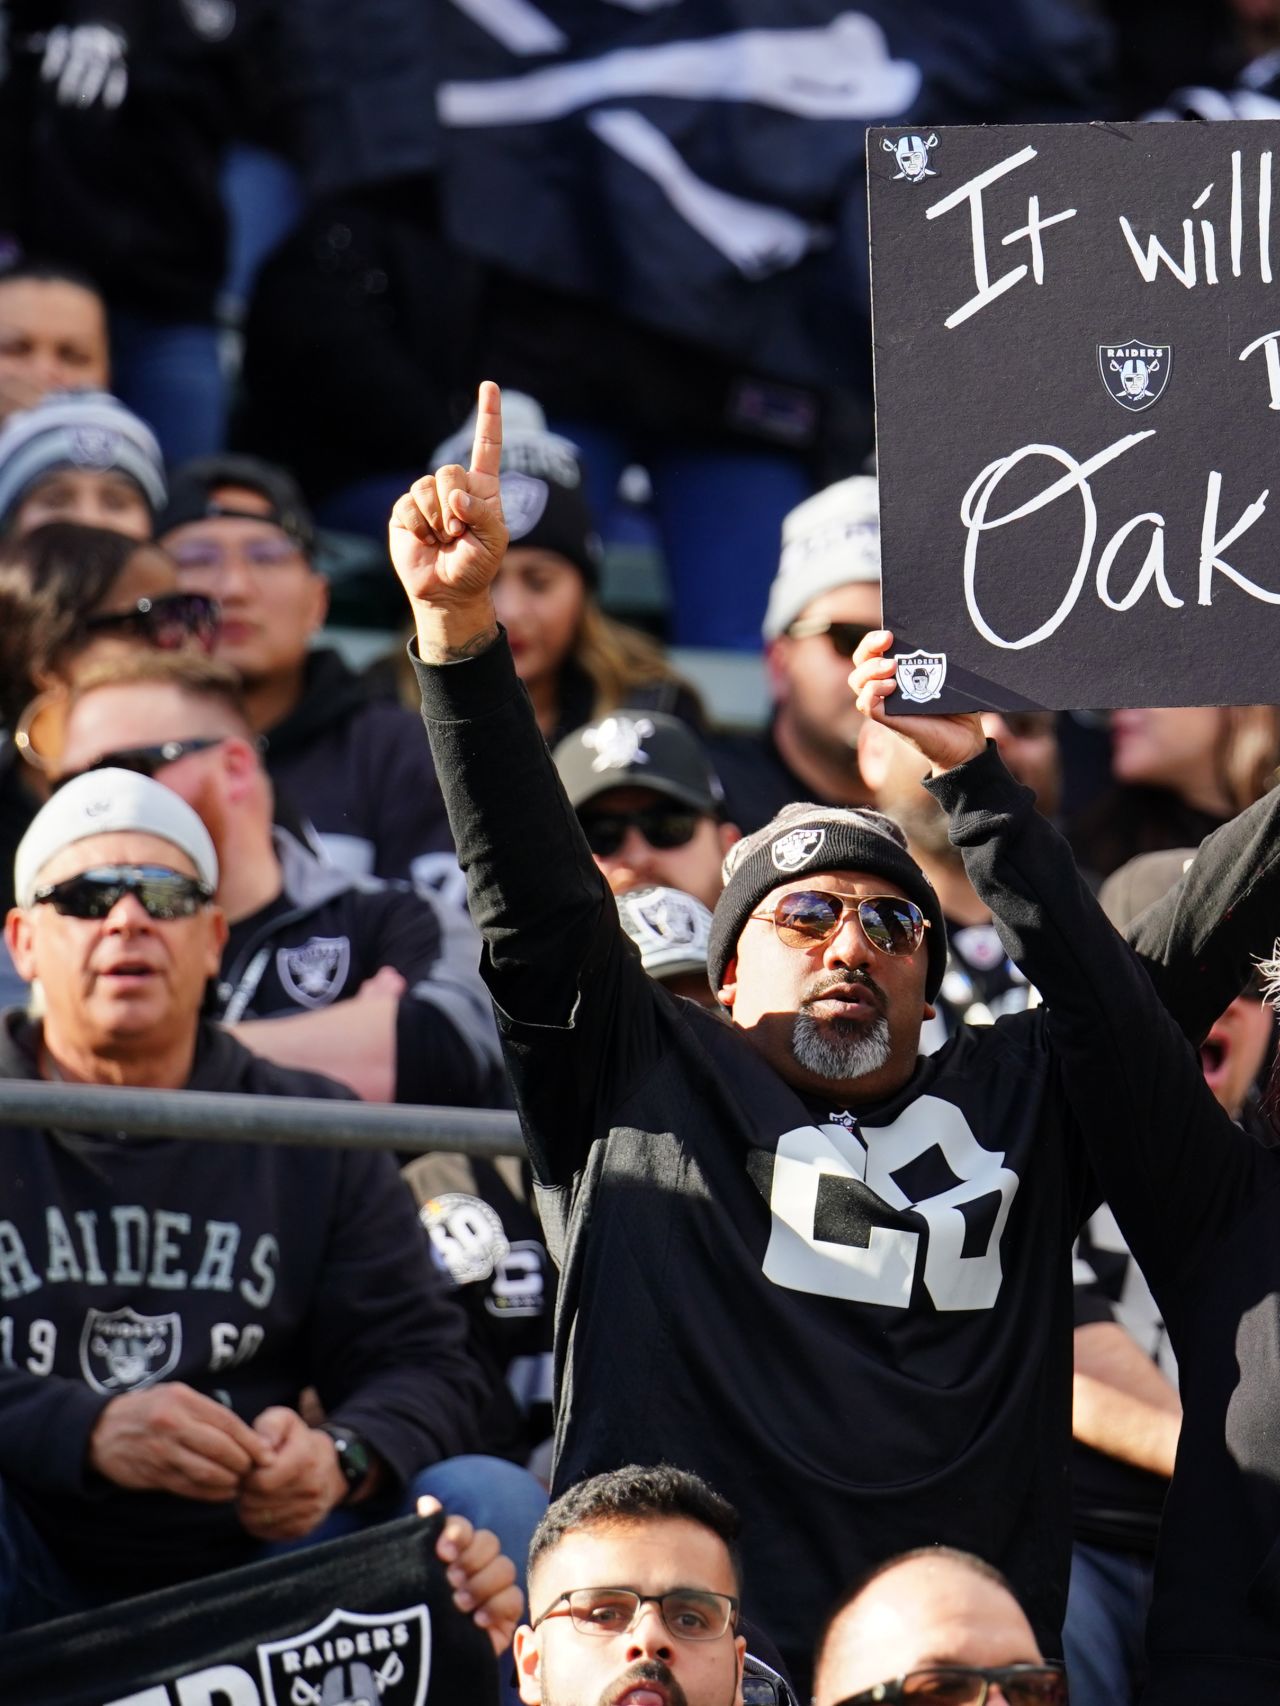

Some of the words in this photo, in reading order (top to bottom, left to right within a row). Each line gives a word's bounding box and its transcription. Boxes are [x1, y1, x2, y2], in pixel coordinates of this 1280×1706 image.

[926, 145, 1077, 329] It
[1119, 151, 1272, 289] will
[1107, 349, 1163, 357] RAIDERS
[0, 1204, 281, 1310] RAIDERS
[281, 1623, 409, 1674] RAIDERS
